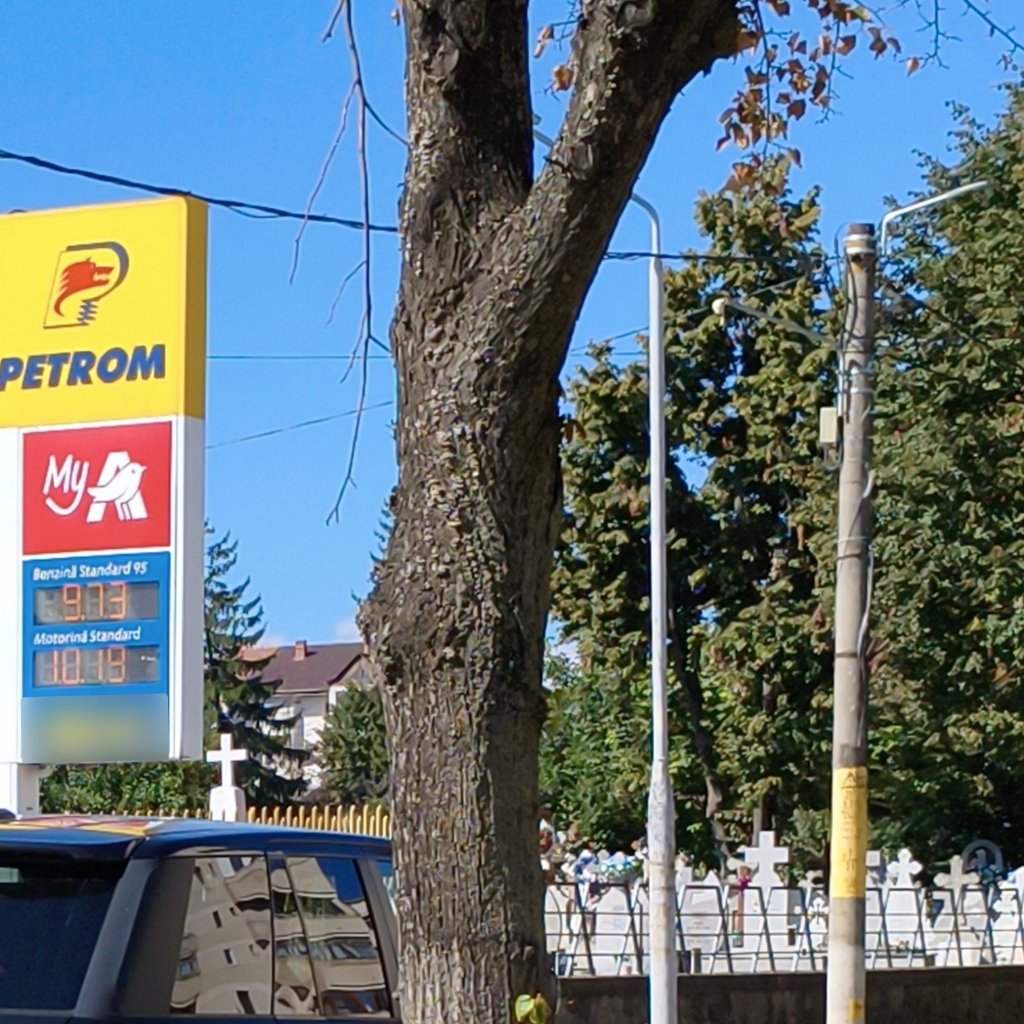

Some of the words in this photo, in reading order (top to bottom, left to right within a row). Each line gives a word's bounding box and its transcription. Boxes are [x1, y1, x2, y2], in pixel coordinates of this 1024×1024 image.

[42, 454, 89, 516] My
[79, 560, 132, 578] Standard
[133, 560, 149, 576] 95
[62, 582, 127, 621] 9.73
[89, 626, 142, 643] Standard
[53, 646, 126, 685] 10.19
